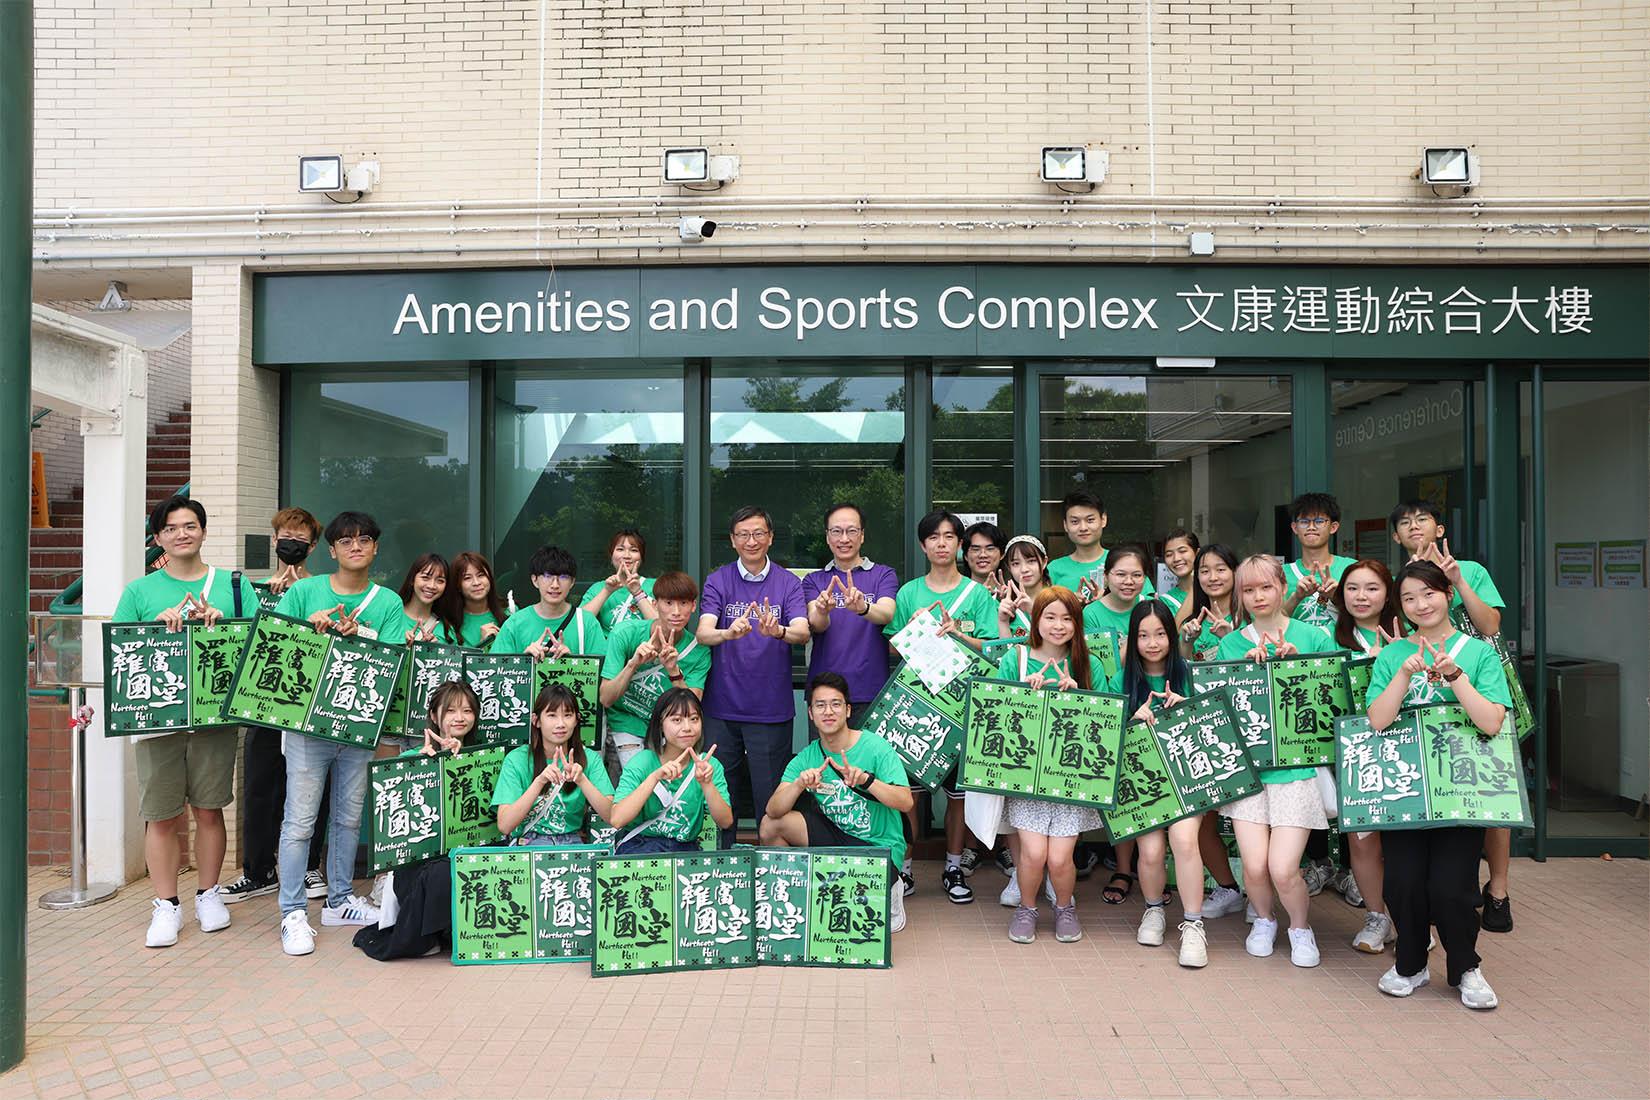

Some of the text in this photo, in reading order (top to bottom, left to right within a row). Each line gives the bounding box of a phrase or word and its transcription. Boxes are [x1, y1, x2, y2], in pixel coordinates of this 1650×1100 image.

[392, 285, 1159, 341] Amenities and Sports Complex
[1177, 284, 1594, 335] 文康運動綜合大樓
